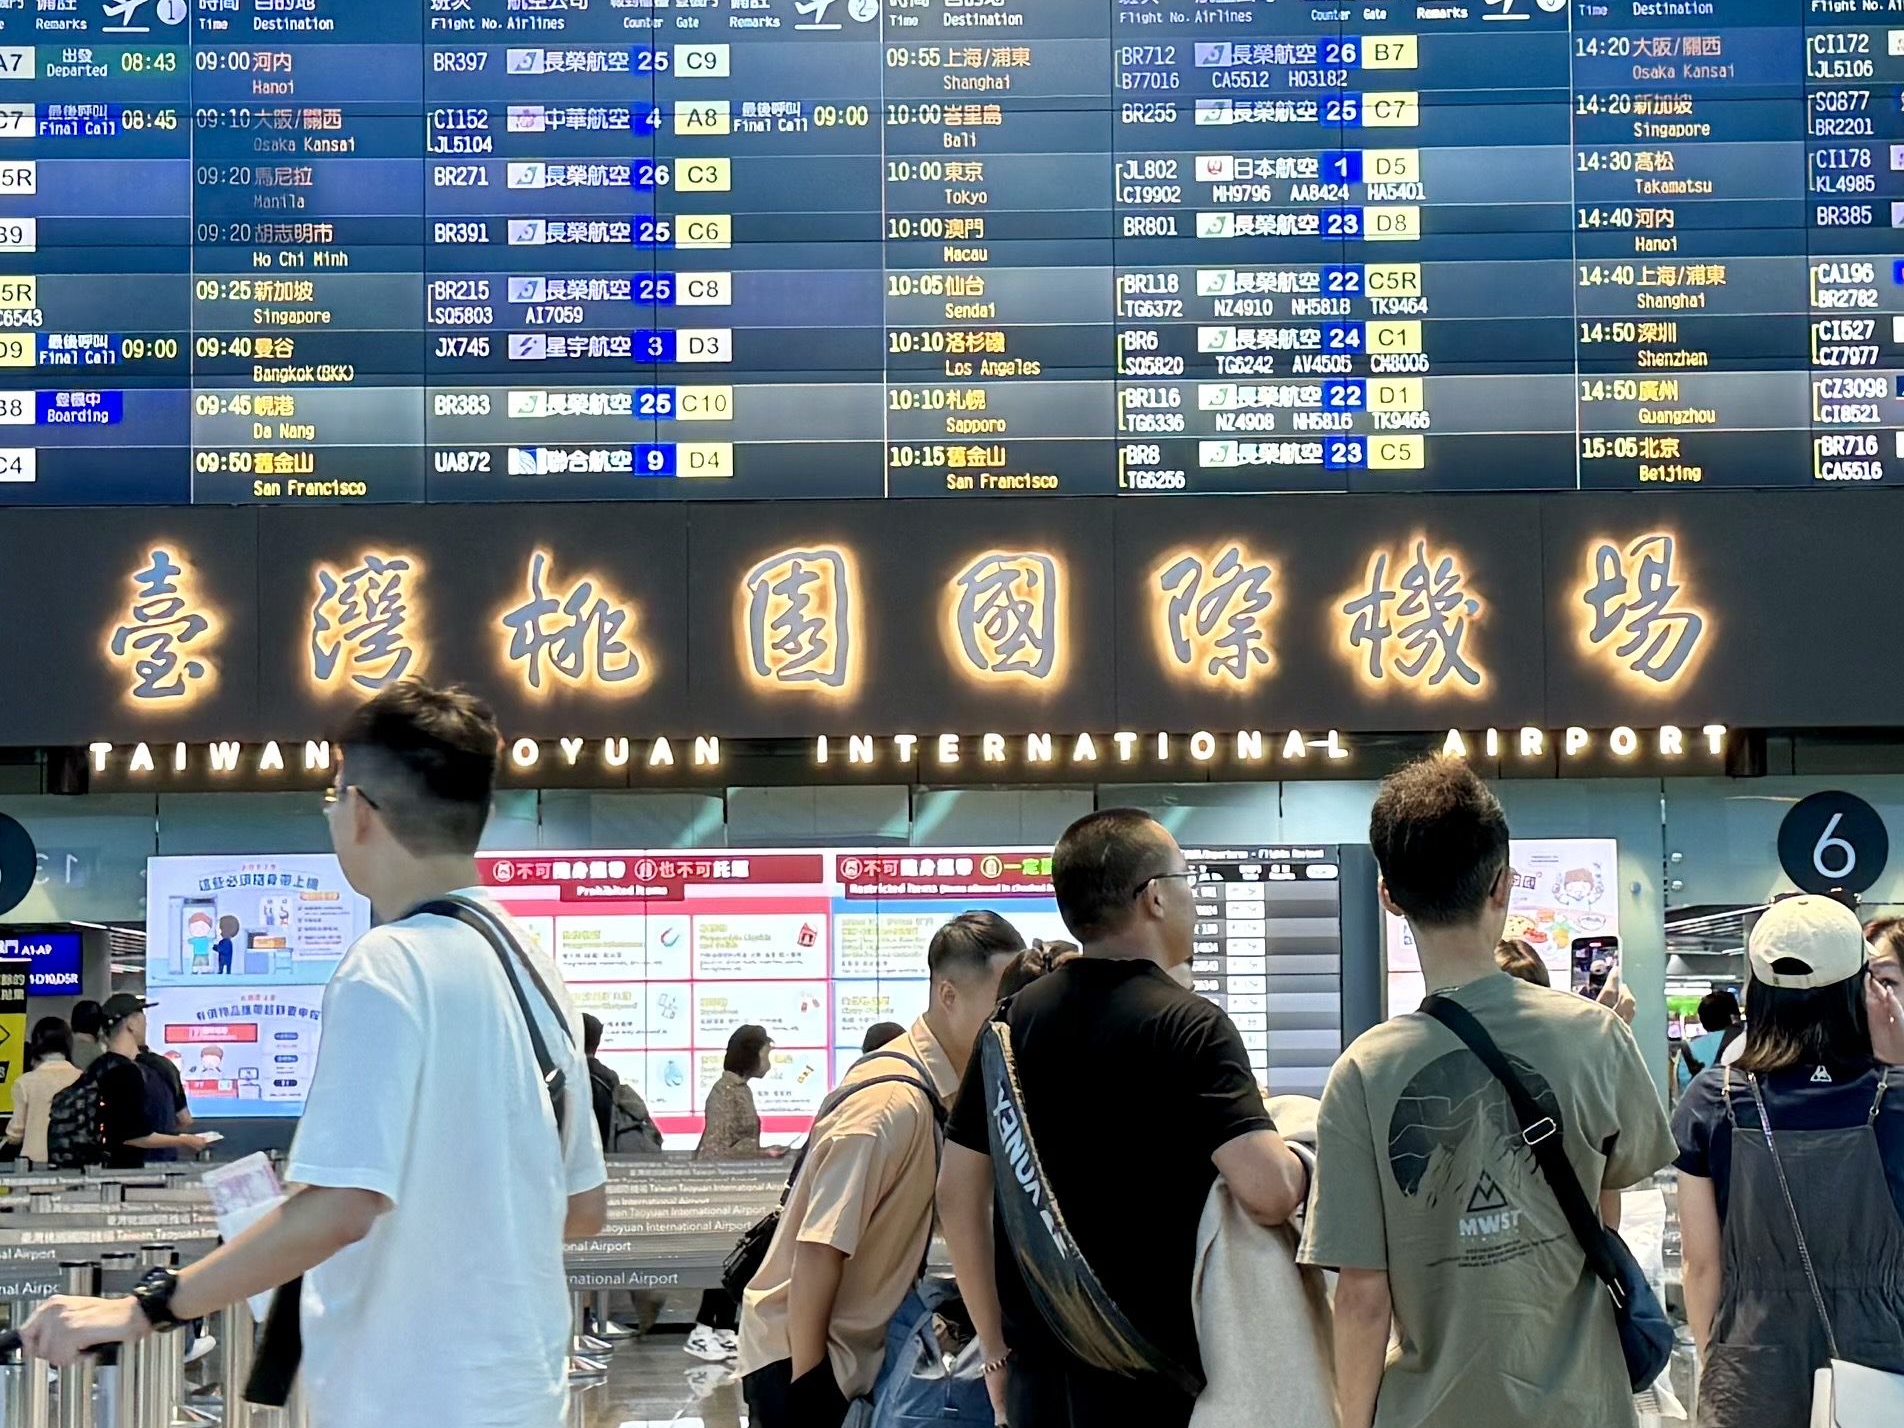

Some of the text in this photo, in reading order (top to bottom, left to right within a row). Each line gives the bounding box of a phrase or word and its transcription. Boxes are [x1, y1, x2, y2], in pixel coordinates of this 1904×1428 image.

[1576, 34, 1869, 56] 14:20 CI172
[122, 53, 175, 71] 08:43
[196, 52, 487, 71] 09:00 BR397
[887, 46, 1175, 67] 09:55 BR712
[1576, 91, 1869, 114] 14:20 SQ877
[121, 110, 176, 132] 08:45
[196, 106, 868, 129] 09:10 CI152 09:00
[887, 103, 1176, 124] 10:00 BR255
[888, 160, 1177, 181] 10:00 JL802
[1577, 151, 1631, 171] 14:30
[1817, 149, 1870, 168] CI178
[197, 166, 488, 186] 09:20 BR271
[1635, 178, 1712, 193] Takamatsu
[889, 217, 1177, 237] 10:00 BR801
[1578, 206, 1872, 228] 14:40 河內 BR385
[197, 223, 489, 242] 09:20 BR391
[889, 274, 1178, 295] 10:05 BR118
[1580, 264, 1873, 285] 14:40 CA196
[197, 281, 489, 301] 09:25 新加坡 BR215
[254, 308, 330, 325] Singapore
[890, 331, 1158, 352] 10:10 BR6
[1581, 320, 1874, 343] 14:50 深圳 CI527
[122, 339, 177, 358] 09:00
[197, 337, 489, 357] 09:40 JX745
[1638, 350, 1707, 366] Shenzhen
[890, 388, 1180, 409] 10:10 BR116
[1582, 378, 1887, 400] 14:50 CZ3098
[196, 395, 490, 415] 09:45 BR383
[890, 445, 1160, 467] 10:15 BR8
[1582, 435, 1878, 458] 15:05 北京 BR716
[196, 452, 490, 472] 09:50 UA872
[1640, 465, 1701, 482] Beijing
[89, 722, 1726, 771] TAIWAN OYUAN INTERNATIONAL AIRPORT
[1813, 813, 1855, 878] 6
[604, 1223, 643, 1233] aoyuan
[1458, 1210, 1520, 1236] MWST
[14, 1247, 56, 1260] Airport
[591, 1241, 632, 1253] Airport
[629, 1272, 678, 1286] Airport
